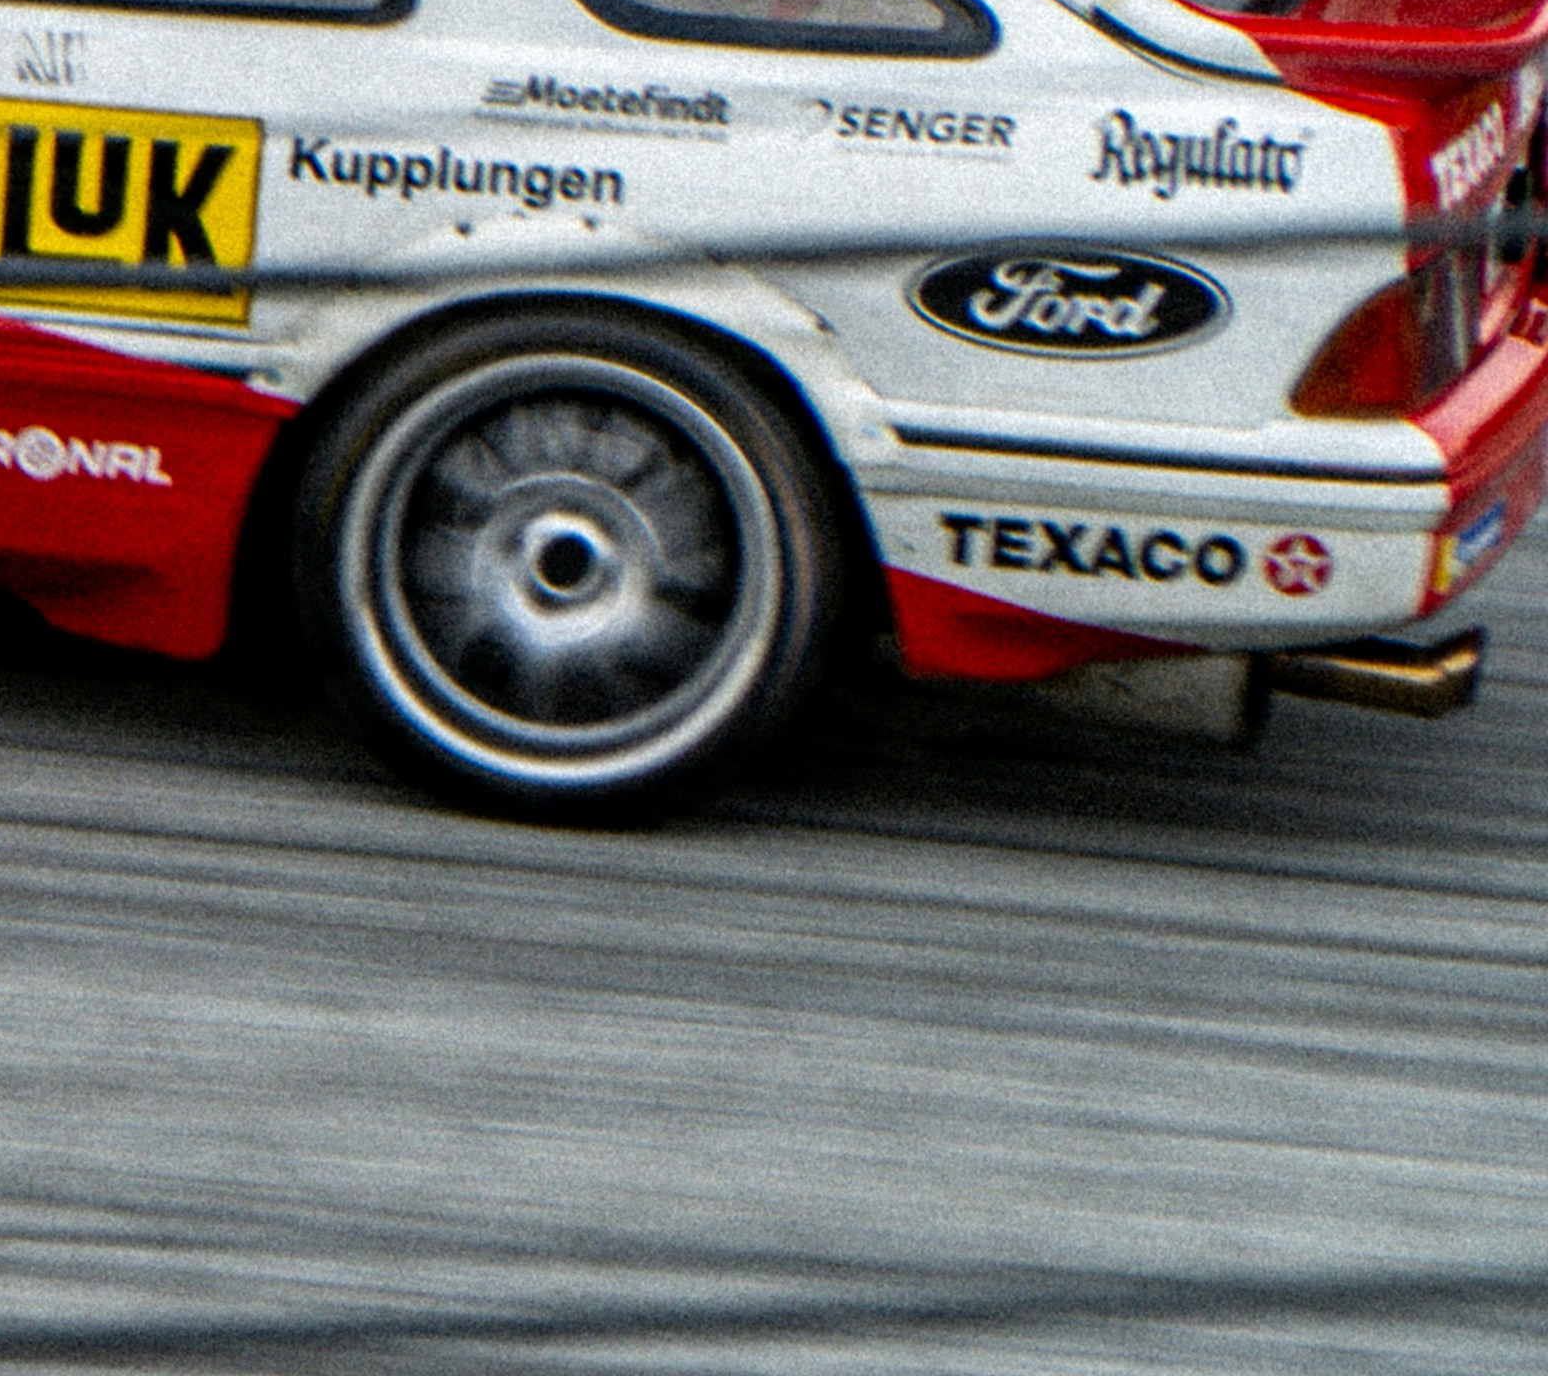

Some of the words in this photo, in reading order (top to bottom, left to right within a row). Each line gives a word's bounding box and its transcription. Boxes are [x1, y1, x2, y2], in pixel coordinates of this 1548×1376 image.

[838, 107, 1018, 149] SENGER
[289, 136, 625, 209] Kupplungen
[967, 257, 1166, 339] Ford
[940, 512, 1249, 587] TEXACO
